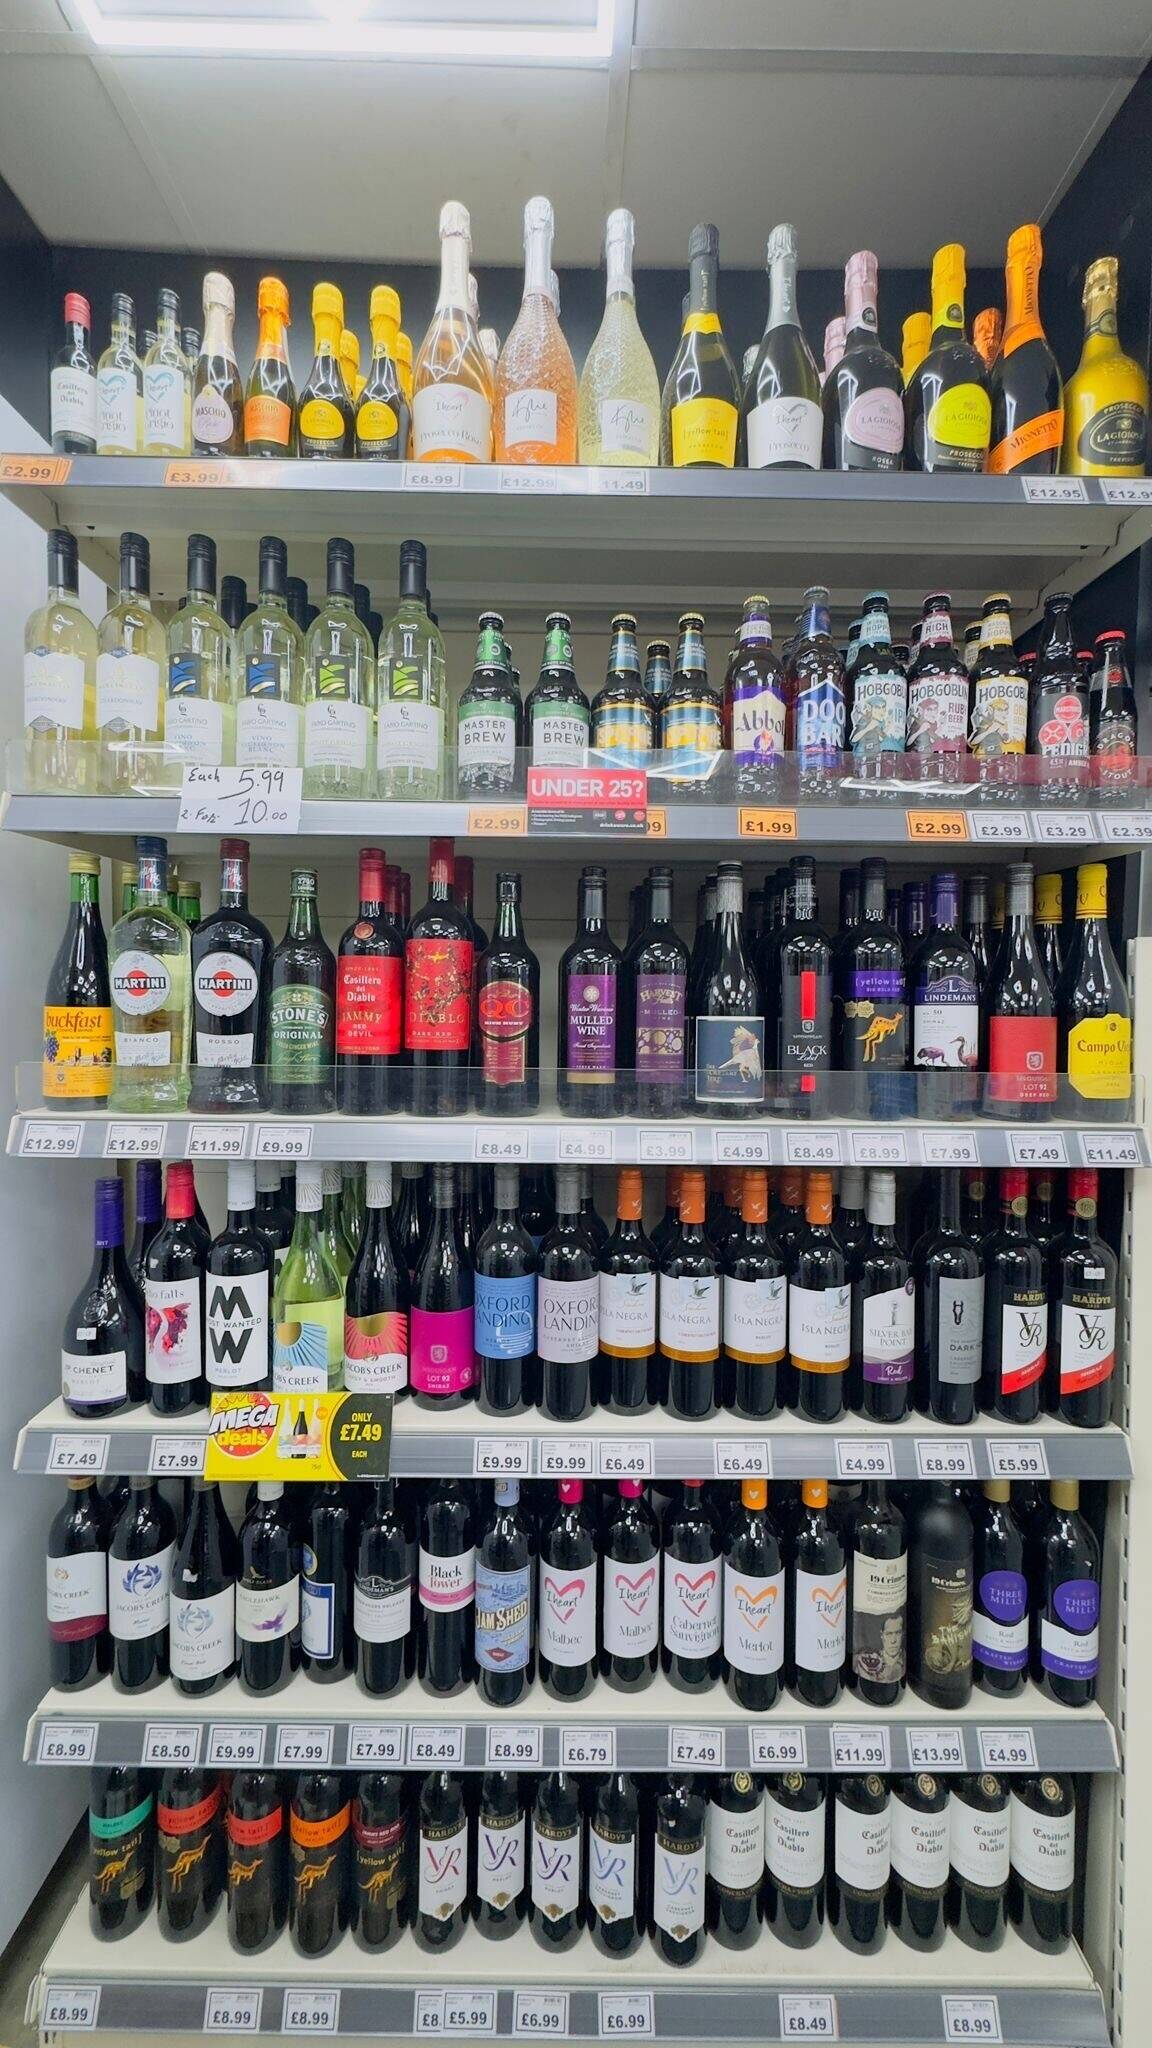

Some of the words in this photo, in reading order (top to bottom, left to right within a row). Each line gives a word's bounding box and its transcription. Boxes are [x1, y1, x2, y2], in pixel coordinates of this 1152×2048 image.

[1104, 403, 1142, 414] PROSECCO
[1010, 418, 1058, 450] MIONETTO
[2, 465, 51, 479] £2.99
[170, 472, 219, 483] £3.99
[411, 475, 453, 485] £8.99
[503, 478, 554, 488] £12.99
[1030, 488, 1081, 499] £12.95
[912, 684, 968, 703] HOBGOBLIN
[804, 699, 845, 724] DOO
[464, 720, 506, 731] MASTER
[543, 721, 585, 732] MASTER
[464, 732, 506, 745] BREW
[543, 732, 585, 747] BREW
[803, 724, 844, 748] BAR
[1097, 732, 1135, 750] DRAGON
[1102, 768, 1133, 780] STOUT
[226, 769, 284, 798] 5.99
[531, 779, 604, 798] UNDER
[609, 780, 644, 798] 25?
[234, 798, 287, 825] 10.00
[473, 818, 520, 830] £2.99
[745, 821, 792, 834] £1.99
[915, 823, 961, 835] £2.99
[982, 826, 1022, 837] £2.99
[1046, 827, 1087, 838] £3.29
[1112, 827, 1152, 838] £2.39
[115, 977, 165, 990] MARTINI
[200, 977, 251, 991] MARTINI
[343, 975, 381, 986] Casillero
[346, 991, 376, 1002] Diablo
[271, 1008, 328, 1026] STONE'S
[570, 1015, 614, 1025] MULLED
[273, 1030, 323, 1040] ORIGINAL
[576, 1026, 606, 1036] WINE
[787, 1045, 827, 1056] BLACK
[1077, 1040, 1115, 1055] Campo
[1023, 1083, 1038, 1091] LOT
[1039, 1083, 1048, 1091] 92
[25, 1138, 75, 1151] £12.99
[109, 1140, 159, 1151] £12.99
[191, 1140, 241, 1152] £11.99
[262, 1142, 303, 1154] £9.99
[481, 1144, 522, 1155] £8.49
[565, 1144, 606, 1155] £4.99
[647, 1146, 687, 1157] £3.99
[723, 1147, 763, 1158] £4.99
[794, 1148, 834, 1159] £8.49
[859, 1148, 900, 1159] £8.99
[931, 1148, 971, 1159] £7.99
[1019, 1149, 1059, 1160] £7.49
[1087, 1150, 1137, 1161] £11.49
[209, 1286, 254, 1320] M
[614, 1311, 648, 1322] NEGRA
[677, 1313, 712, 1325] NEGRA
[734, 1313, 752, 1325] ISLA
[223, 1318, 262, 1328] WANTED
[801, 1323, 823, 1335] ISLA
[869, 1327, 899, 1338] SILVER
[209, 1328, 253, 1364] W
[880, 1337, 908, 1347] POINT
[73, 1364, 114, 1375] CHENET
[373, 1363, 402, 1375] CREEK
[884, 1364, 904, 1377] Red
[287, 1375, 320, 1386] CREEK
[426, 1374, 441, 1382] LOT
[441, 1374, 450, 1382] 92
[209, 1404, 280, 1435] MEGA
[352, 1412, 373, 1422] ONLY
[217, 1429, 268, 1446] deals
[339, 1423, 382, 1442] £7.49
[57, 1452, 97, 1465] £7.49
[158, 1454, 198, 1467] £7.99
[351, 1450, 368, 1459] EACH
[482, 1456, 522, 1469] £9.99
[546, 1457, 586, 1469] £9.99
[605, 1458, 645, 1471] £6.49
[723, 1458, 762, 1471] £6.49
[845, 1458, 885, 1471] £4.99
[926, 1459, 966, 1471] £8.99
[999, 1459, 1038, 1471] £5.99
[430, 1565, 463, 1577] Black
[429, 1578, 463, 1589] Tower
[989, 1587, 1022, 1597] THREE
[990, 1596, 1022, 1605] MILLS
[1064, 1597, 1096, 1607] THREE
[475, 1607, 495, 1629] JAM
[495, 1600, 528, 1631] SHED
[672, 1615, 717, 1631] Cabernet
[619, 1622, 653, 1637] Malbec
[547, 1628, 583, 1645] Malbec
[738, 1635, 773, 1652] Merlot
[46, 1743, 86, 1756] £8.99
[151, 1745, 191, 1758] £8.50
[215, 1745, 255, 1759] £9.99
[283, 1745, 323, 1759] £7.99
[356, 1743, 395, 1757] £7.99
[416, 1744, 455, 1757] £8.49
[494, 1744, 533, 1757] £8.99
[568, 1748, 607, 1761] £6.79
[677, 1747, 716, 1760] £7.49
[758, 1746, 797, 1759] £6.99
[836, 1748, 883, 1762] £11.99
[913, 1748, 960, 1762] £13.99
[988, 1748, 1027, 1762] £4.99
[726, 1824, 760, 1838] Casillero
[773, 1817, 810, 1837] Casillero
[911, 1825, 947, 1837] Casillero
[973, 1825, 1008, 1837] Casillero
[1033, 1828, 1070, 1841] Casillero
[731, 1842, 757, 1854] Diablo
[777, 1836, 805, 1853] Diablo
[916, 1842, 943, 1854] Diablo
[979, 1842, 1005, 1852] Diablo
[1038, 1846, 1067, 1857] Diablo
[50, 2007, 88, 2021] £8.99
[213, 2010, 251, 2024] £8.99
[290, 2012, 329, 2025] £8.99
[449, 2011, 487, 2025] £5.99
[521, 2013, 560, 2027] £6.99
[607, 2014, 645, 2029] £6.99
[789, 2017, 827, 2031] £8.49
[953, 2018, 991, 2033] £8.99
